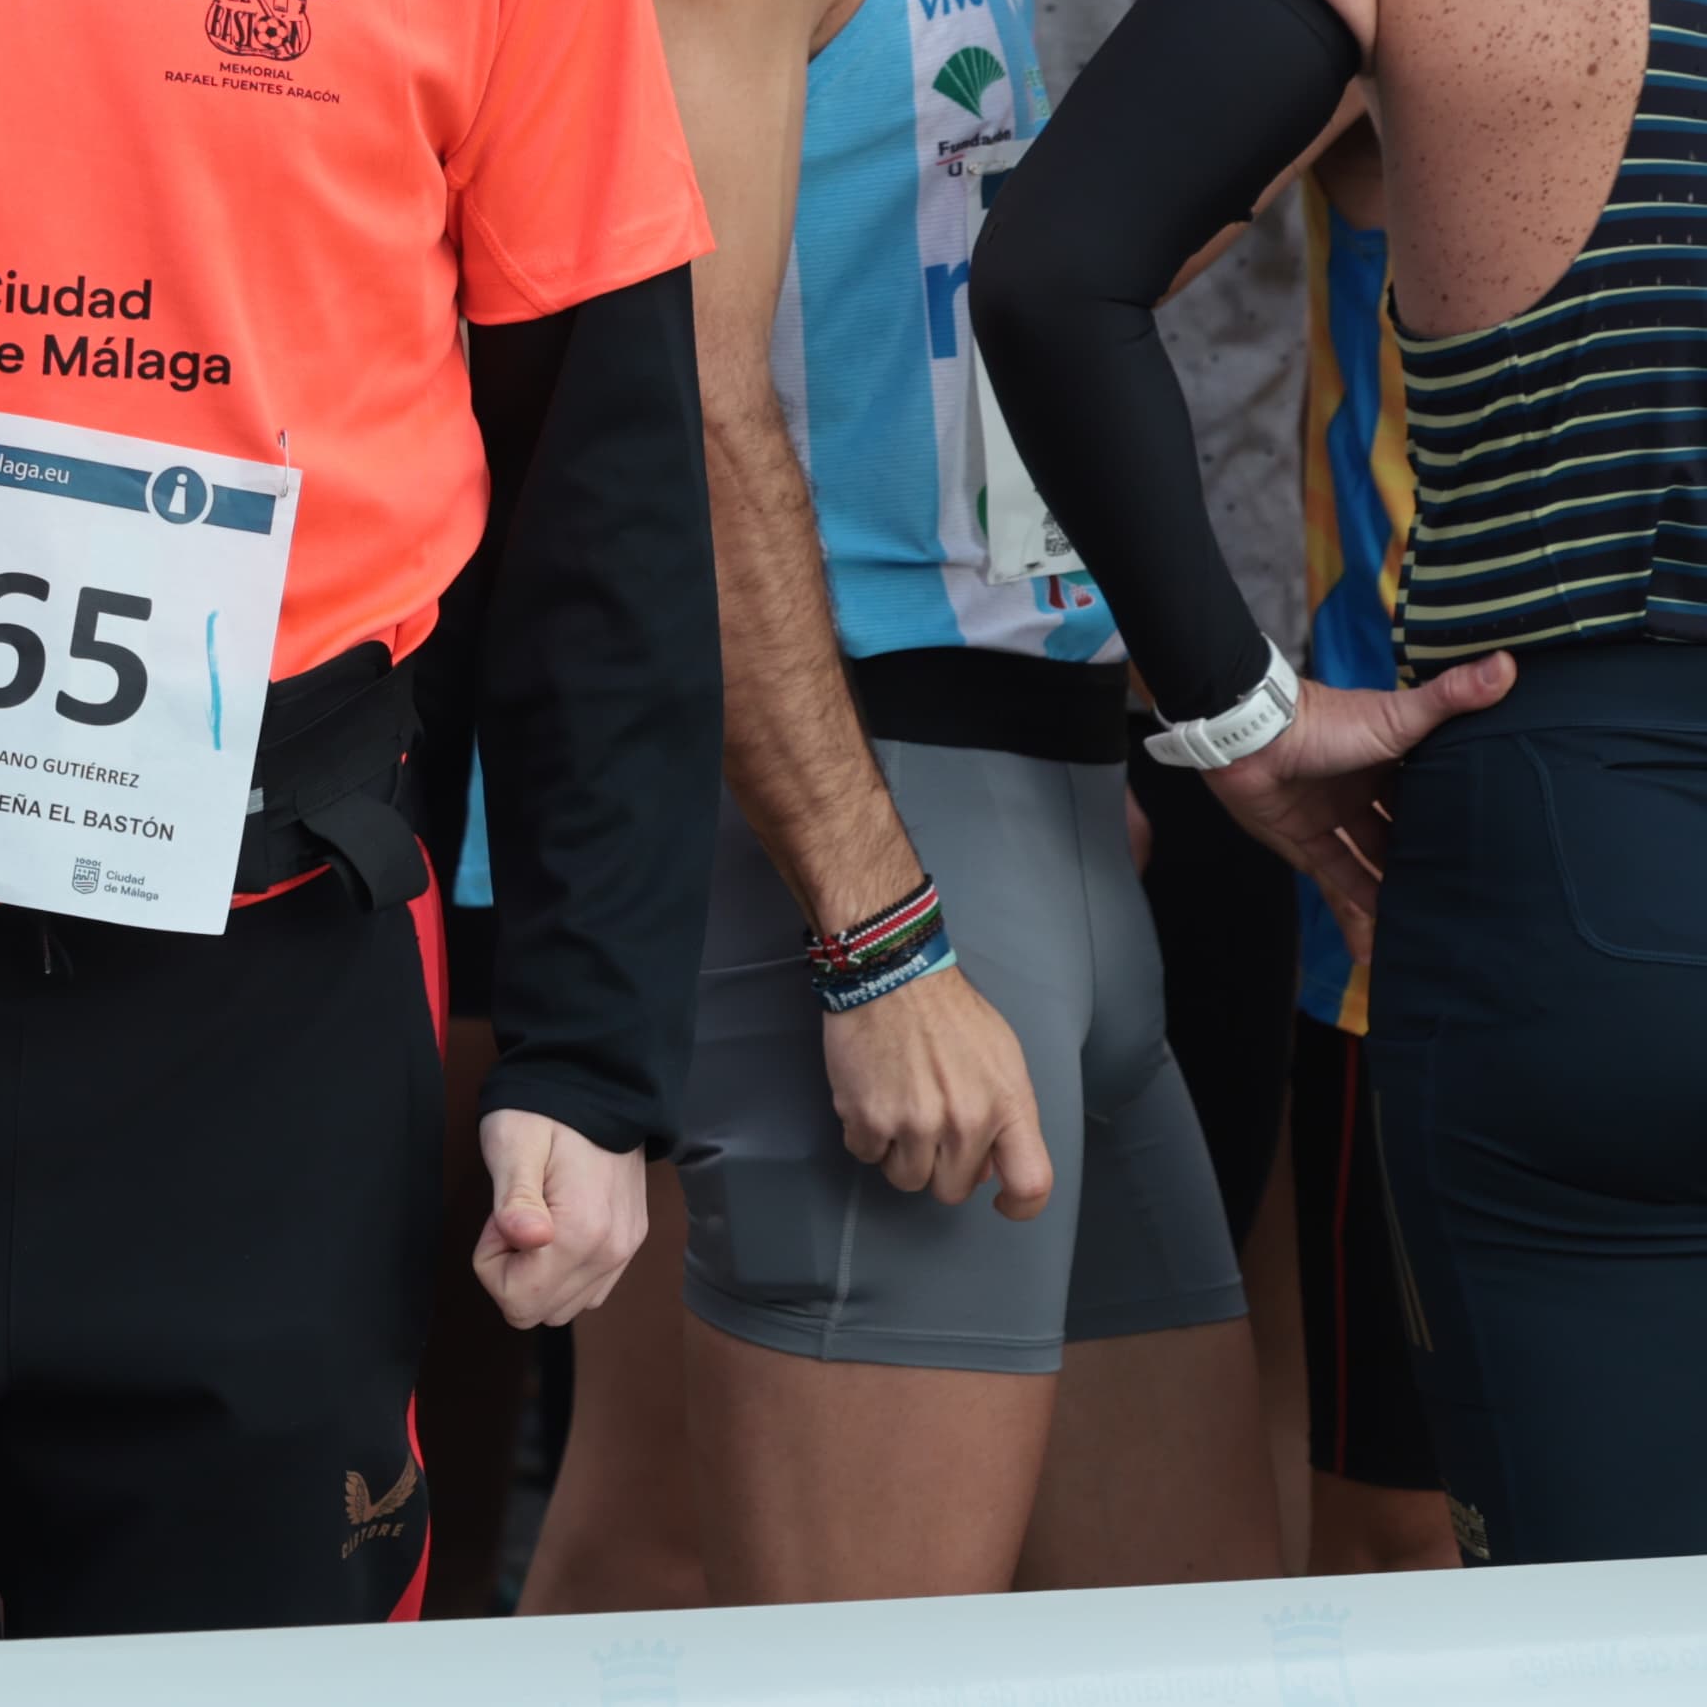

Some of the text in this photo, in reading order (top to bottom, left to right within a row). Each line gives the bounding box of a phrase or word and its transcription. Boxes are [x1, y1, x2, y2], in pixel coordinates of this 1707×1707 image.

[164, 70, 341, 105] RAFAEL FUENTES ARAGÓN
[218, 61, 295, 82] MEMORIAL
[41, 333, 233, 393] Málaga
[42, 757, 141, 789] GUTIÉRREZ
[48, 802, 77, 825] EL
[82, 808, 176, 843] BASTÓN
[103, 882, 160, 902] de Málaga
[105, 869, 146, 886] Ciudad
